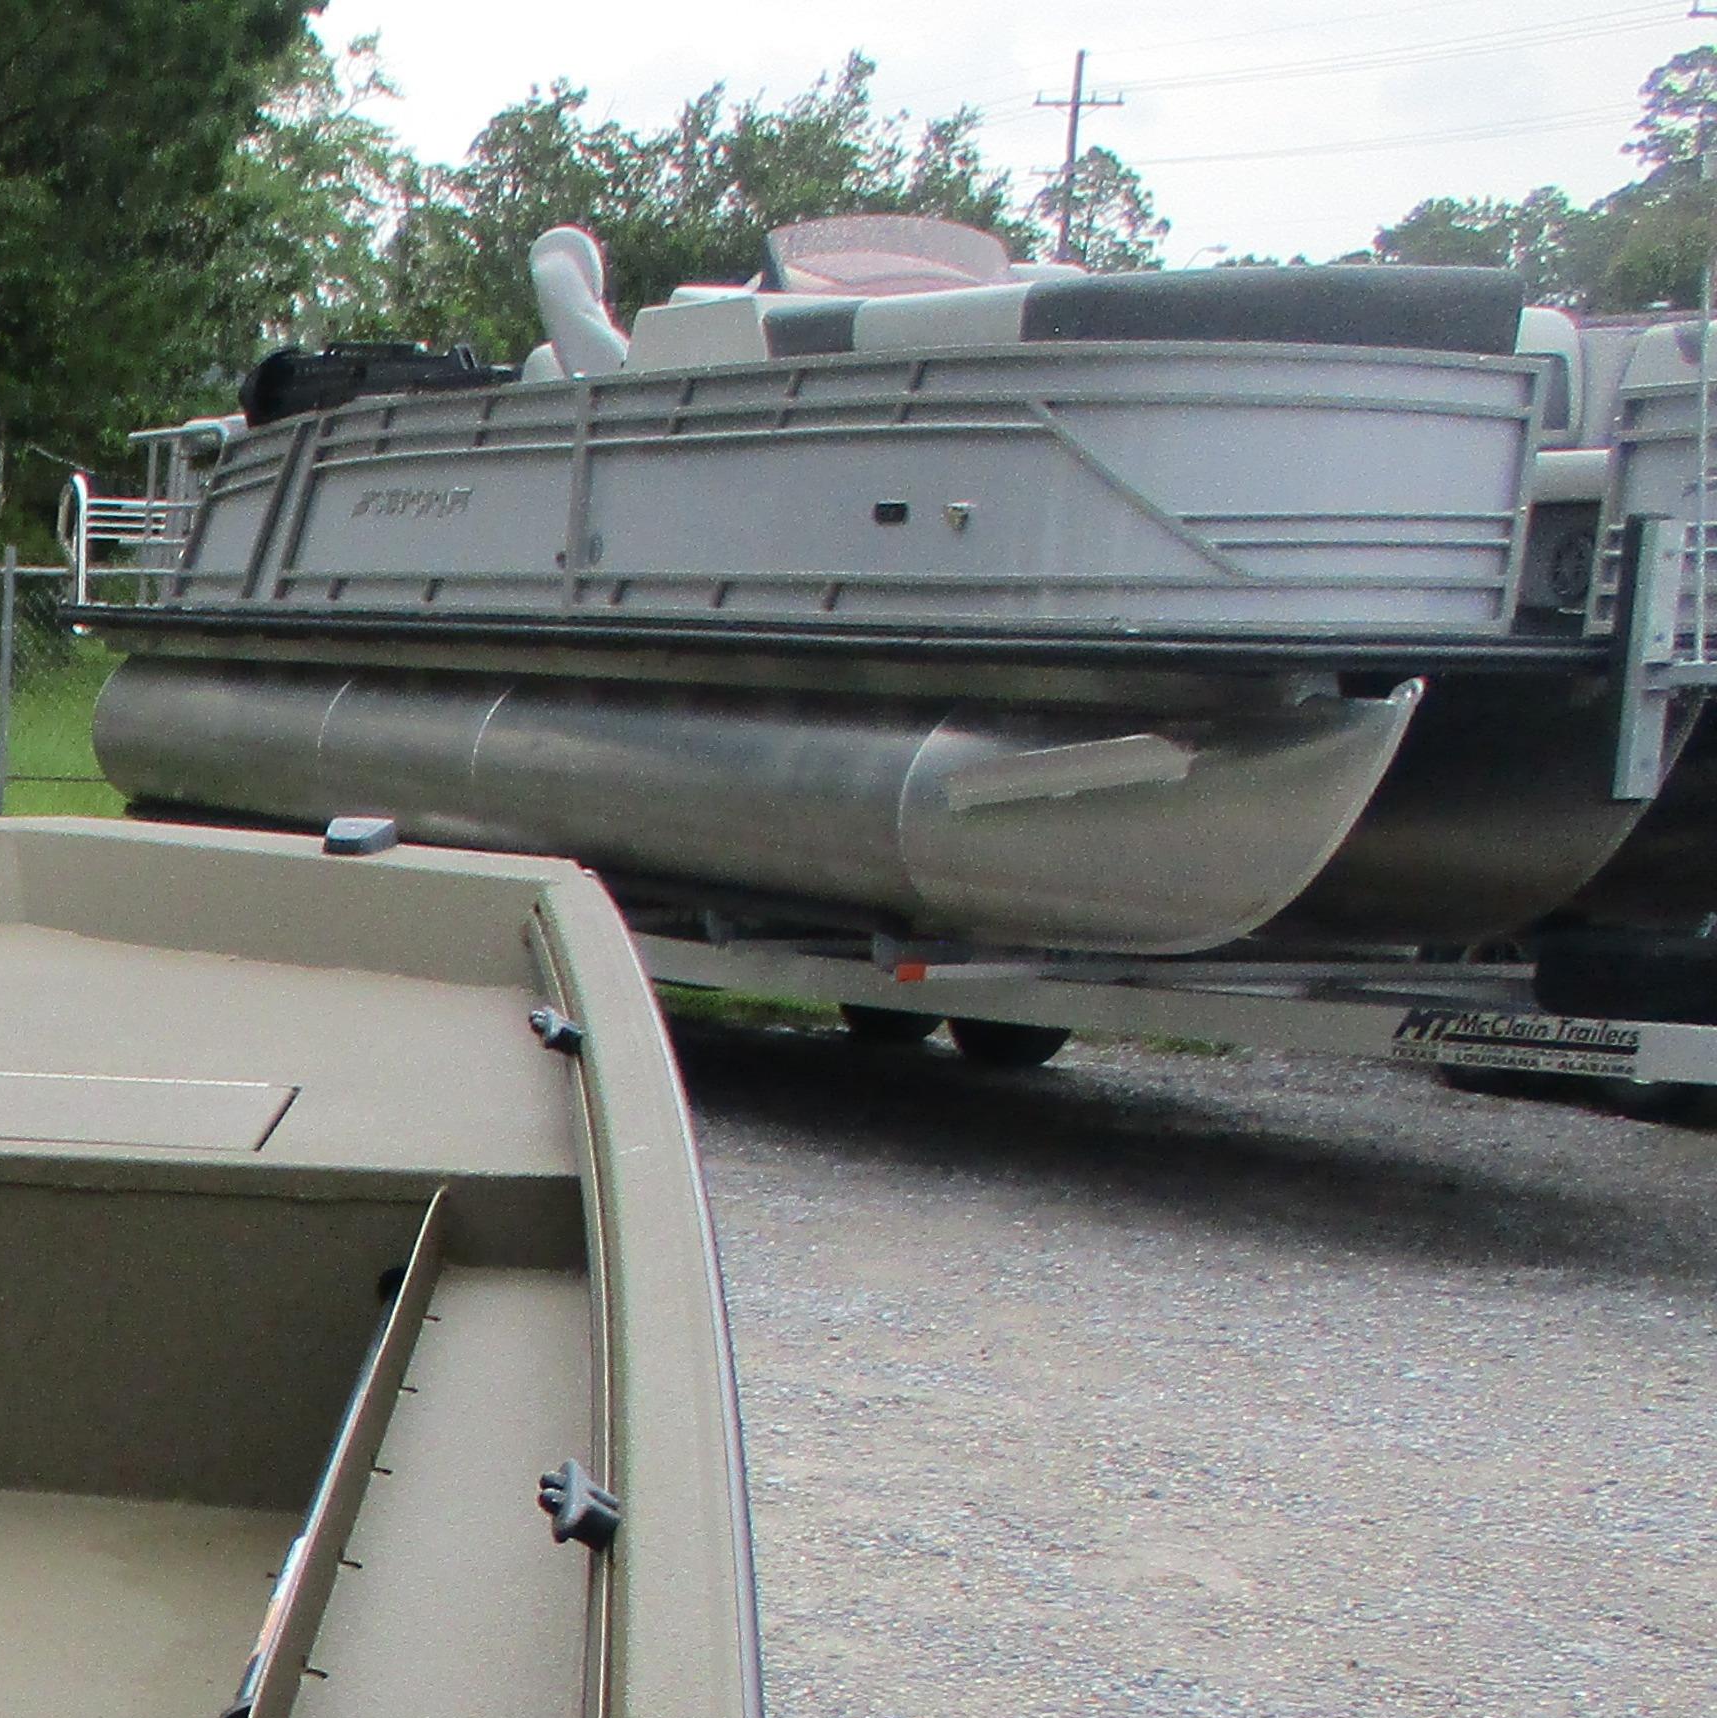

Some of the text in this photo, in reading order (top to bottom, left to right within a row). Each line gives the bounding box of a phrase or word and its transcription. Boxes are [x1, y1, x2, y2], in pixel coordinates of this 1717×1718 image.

[1457, 1013, 1548, 1037] McClain
[1555, 1019, 1640, 1045] Trailers
[1454, 1052, 1539, 1069] LOUISIANA
[1557, 1060, 1635, 1075] ALABAMA
